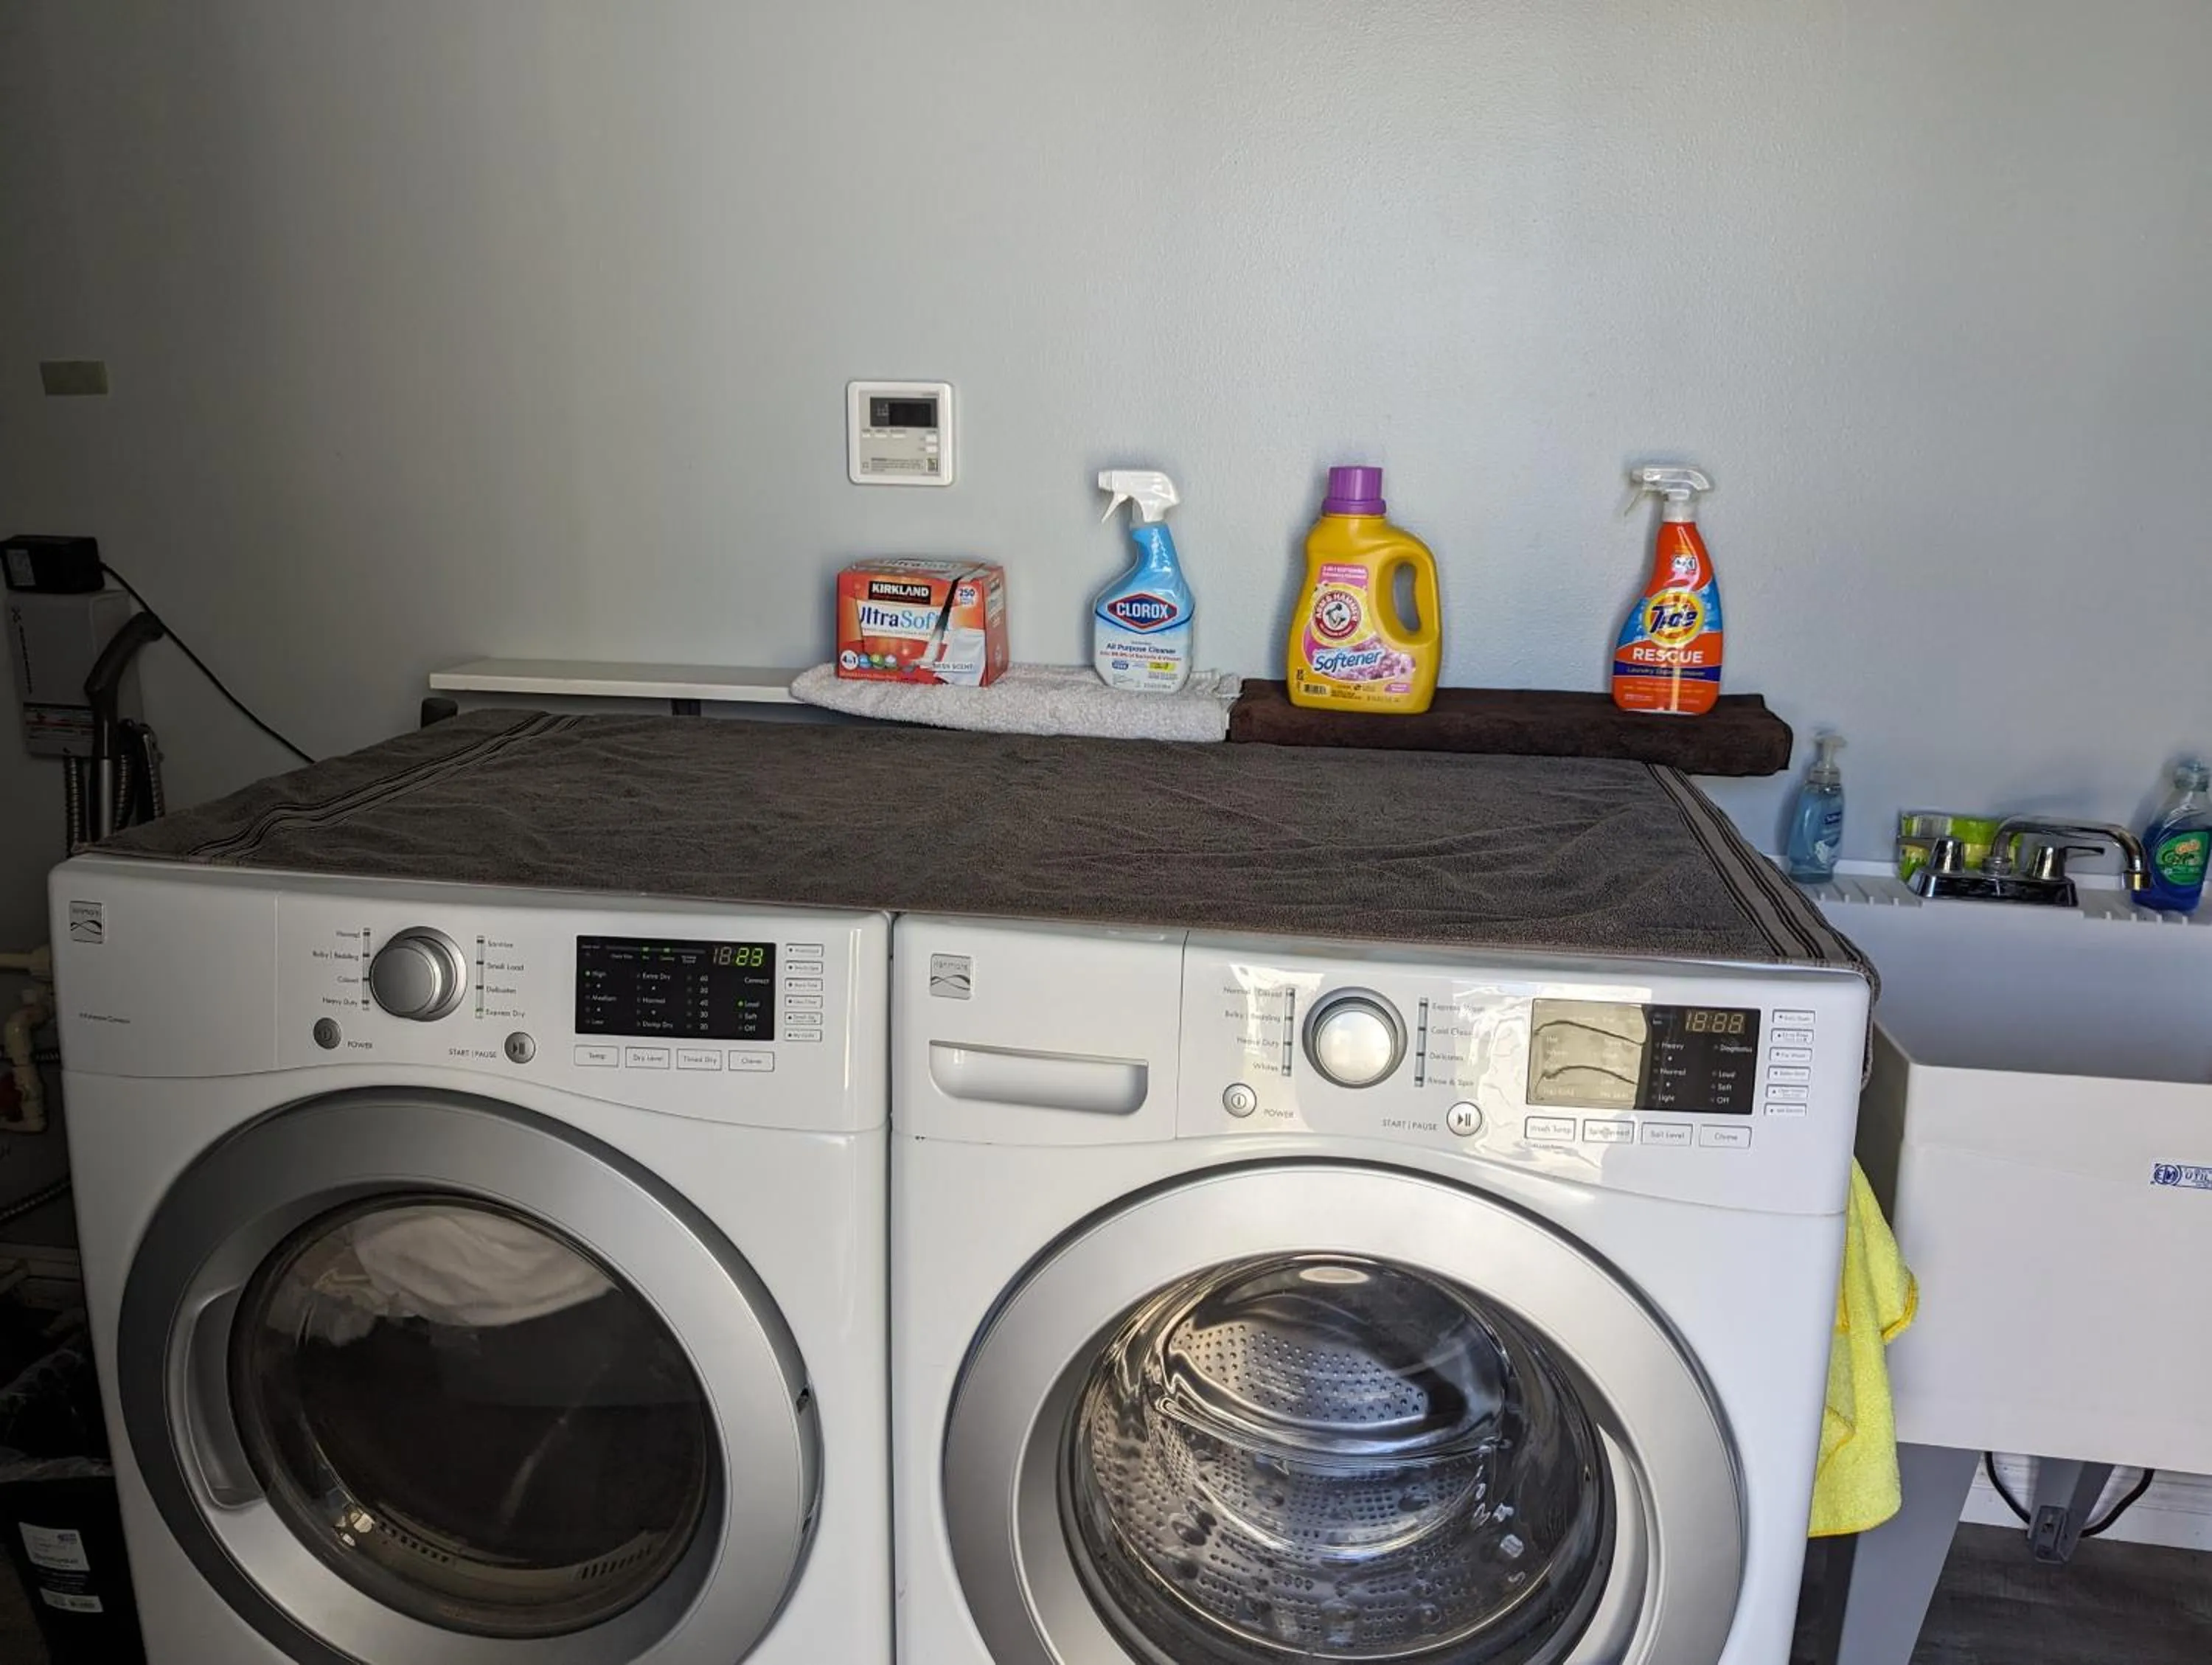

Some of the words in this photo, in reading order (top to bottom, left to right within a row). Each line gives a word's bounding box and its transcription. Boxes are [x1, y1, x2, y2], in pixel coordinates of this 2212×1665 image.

[871, 583, 930, 597] KIRKLAND
[1116, 602, 1169, 619] CLOROX
[1314, 650, 1383, 672] Softener
[1632, 647, 1705, 664] RESCUE
[1661, 1042, 1685, 1051] Heavy
[1716, 1096, 1730, 1105] Off
[1263, 1108, 1294, 1119] POWER
[1382, 1119, 1407, 1127] START
[1412, 1122, 1438, 1130] PAUSE
